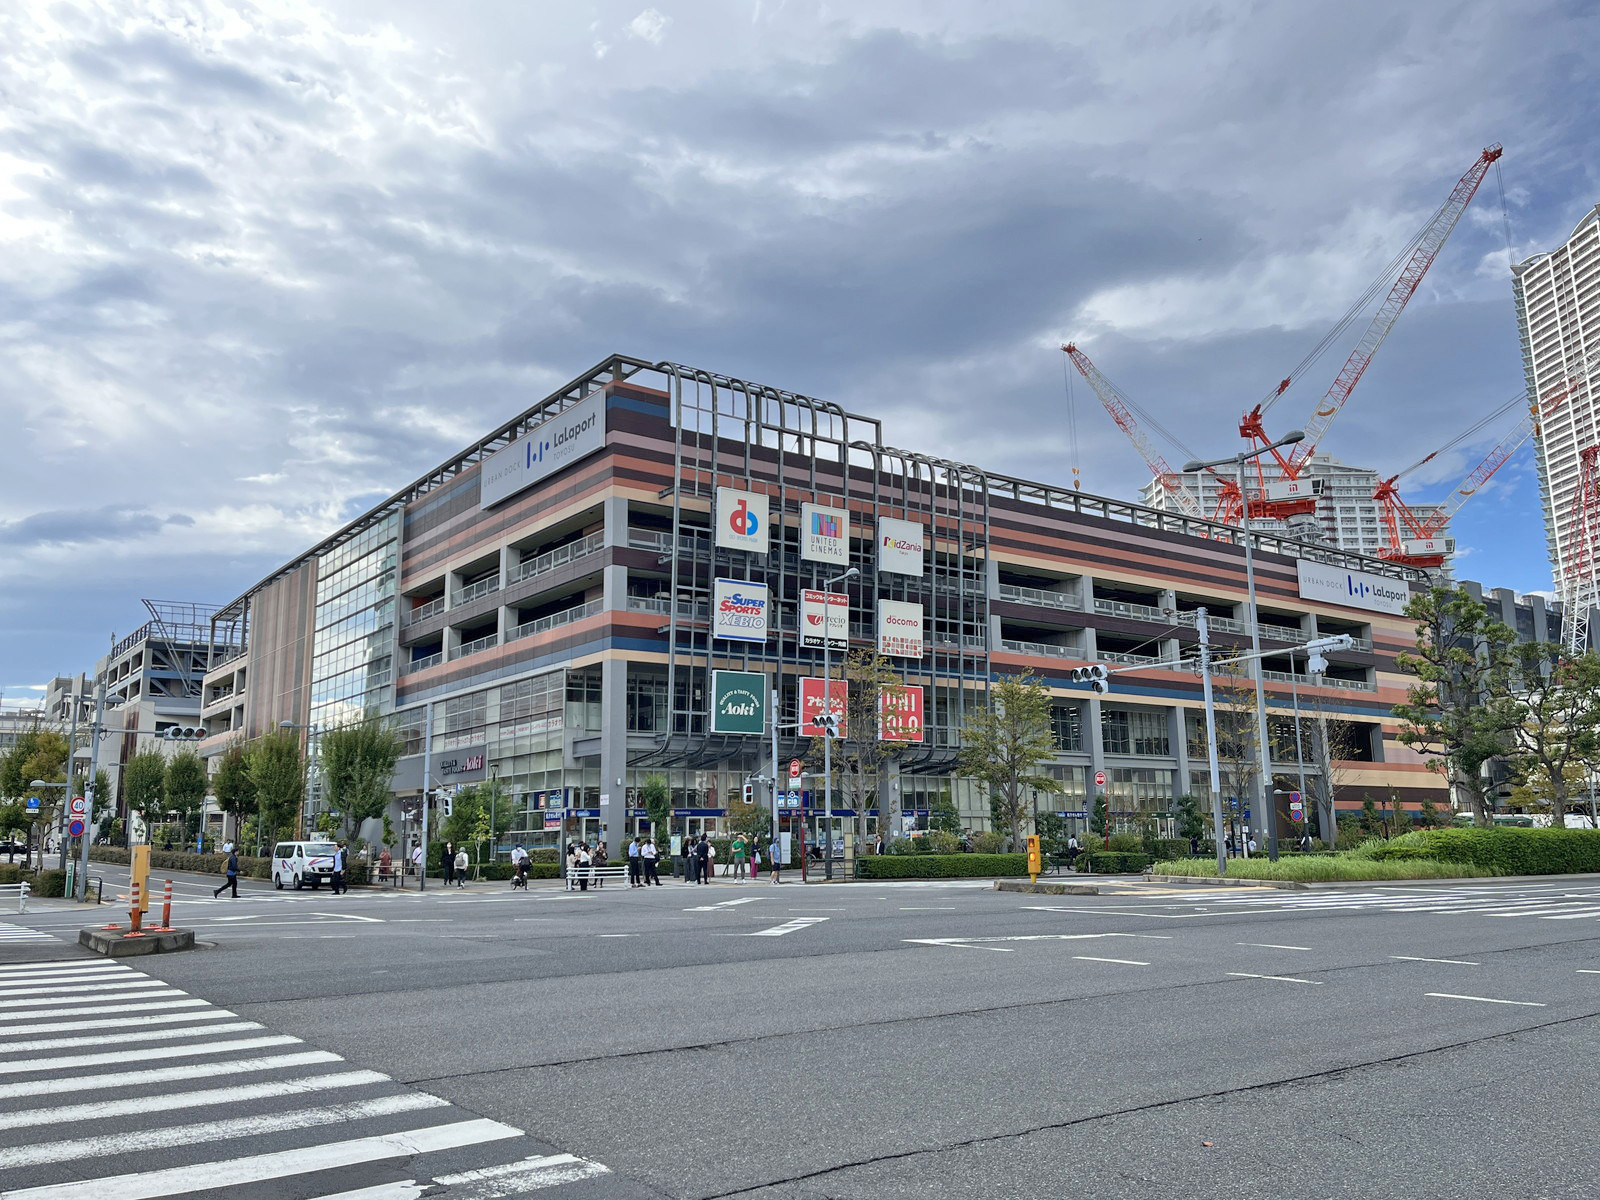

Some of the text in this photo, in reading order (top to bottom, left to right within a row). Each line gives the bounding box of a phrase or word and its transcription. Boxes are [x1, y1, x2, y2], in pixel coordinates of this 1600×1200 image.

[553, 412, 596, 448] LaLaport
[553, 444, 575, 461] TOYOSU
[483, 461, 521, 487] URBAN DOCK
[810, 535, 837, 547] UNITED
[883, 536, 922, 553] KidZania
[810, 544, 843, 557] CINEMAS
[1303, 576, 1344, 590] URBAN DOCK
[731, 593, 766, 608] SUPER
[1372, 584, 1407, 602] LaLaport
[719, 599, 761, 616] SPORTS
[719, 612, 766, 630] XEBIO
[886, 615, 919, 627] docomo
[719, 690, 734, 706] QUALITY
[737, 689, 750, 697] TASTY
[886, 691, 916, 712] UNI
[721, 702, 755, 716] Aoki
[886, 714, 919, 737] QLO
[463, 755, 484, 771] Aoki
[74, 801, 84, 809] 40
